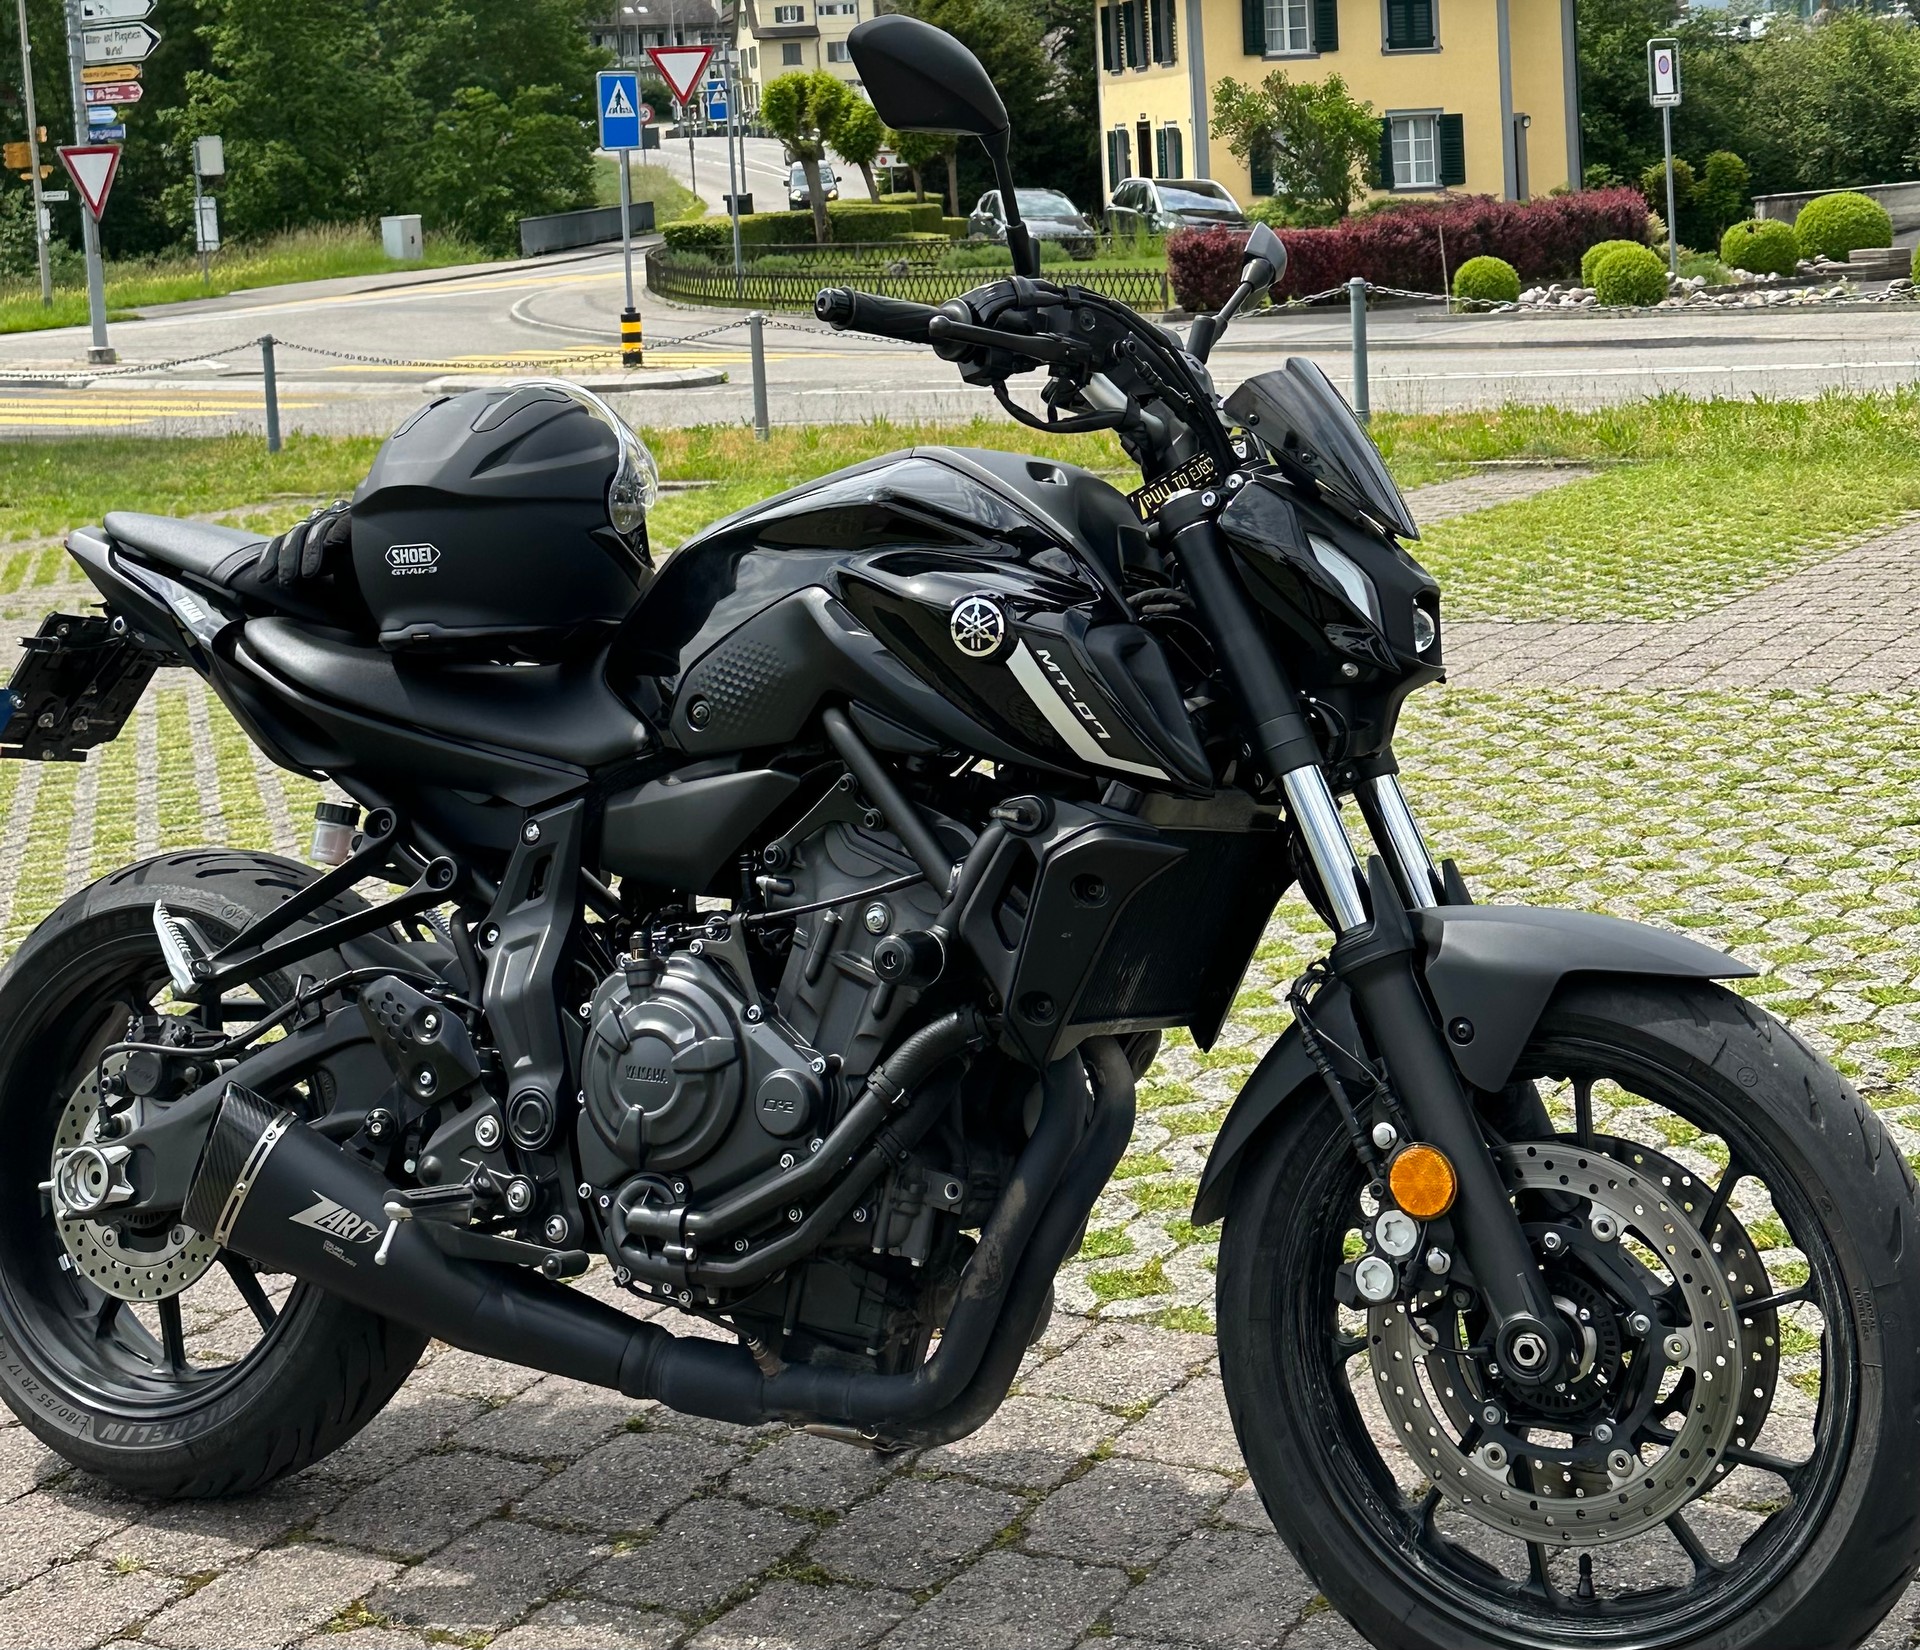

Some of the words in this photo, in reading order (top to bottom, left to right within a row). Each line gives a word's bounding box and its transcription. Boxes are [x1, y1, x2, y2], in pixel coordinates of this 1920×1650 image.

[1142, 482, 1172, 509] PULL
[1171, 472, 1190, 490] TO
[391, 546, 432, 564] SHOEI
[1036, 649, 1111, 739] MT-07
[625, 1064, 669, 1085] YAMAHA
[7, 1363, 23, 1377] 17
[21, 1376, 39, 1395] ZR
[37, 1394, 80, 1426] 180/55
[98, 1393, 240, 1443] MICHELIN
